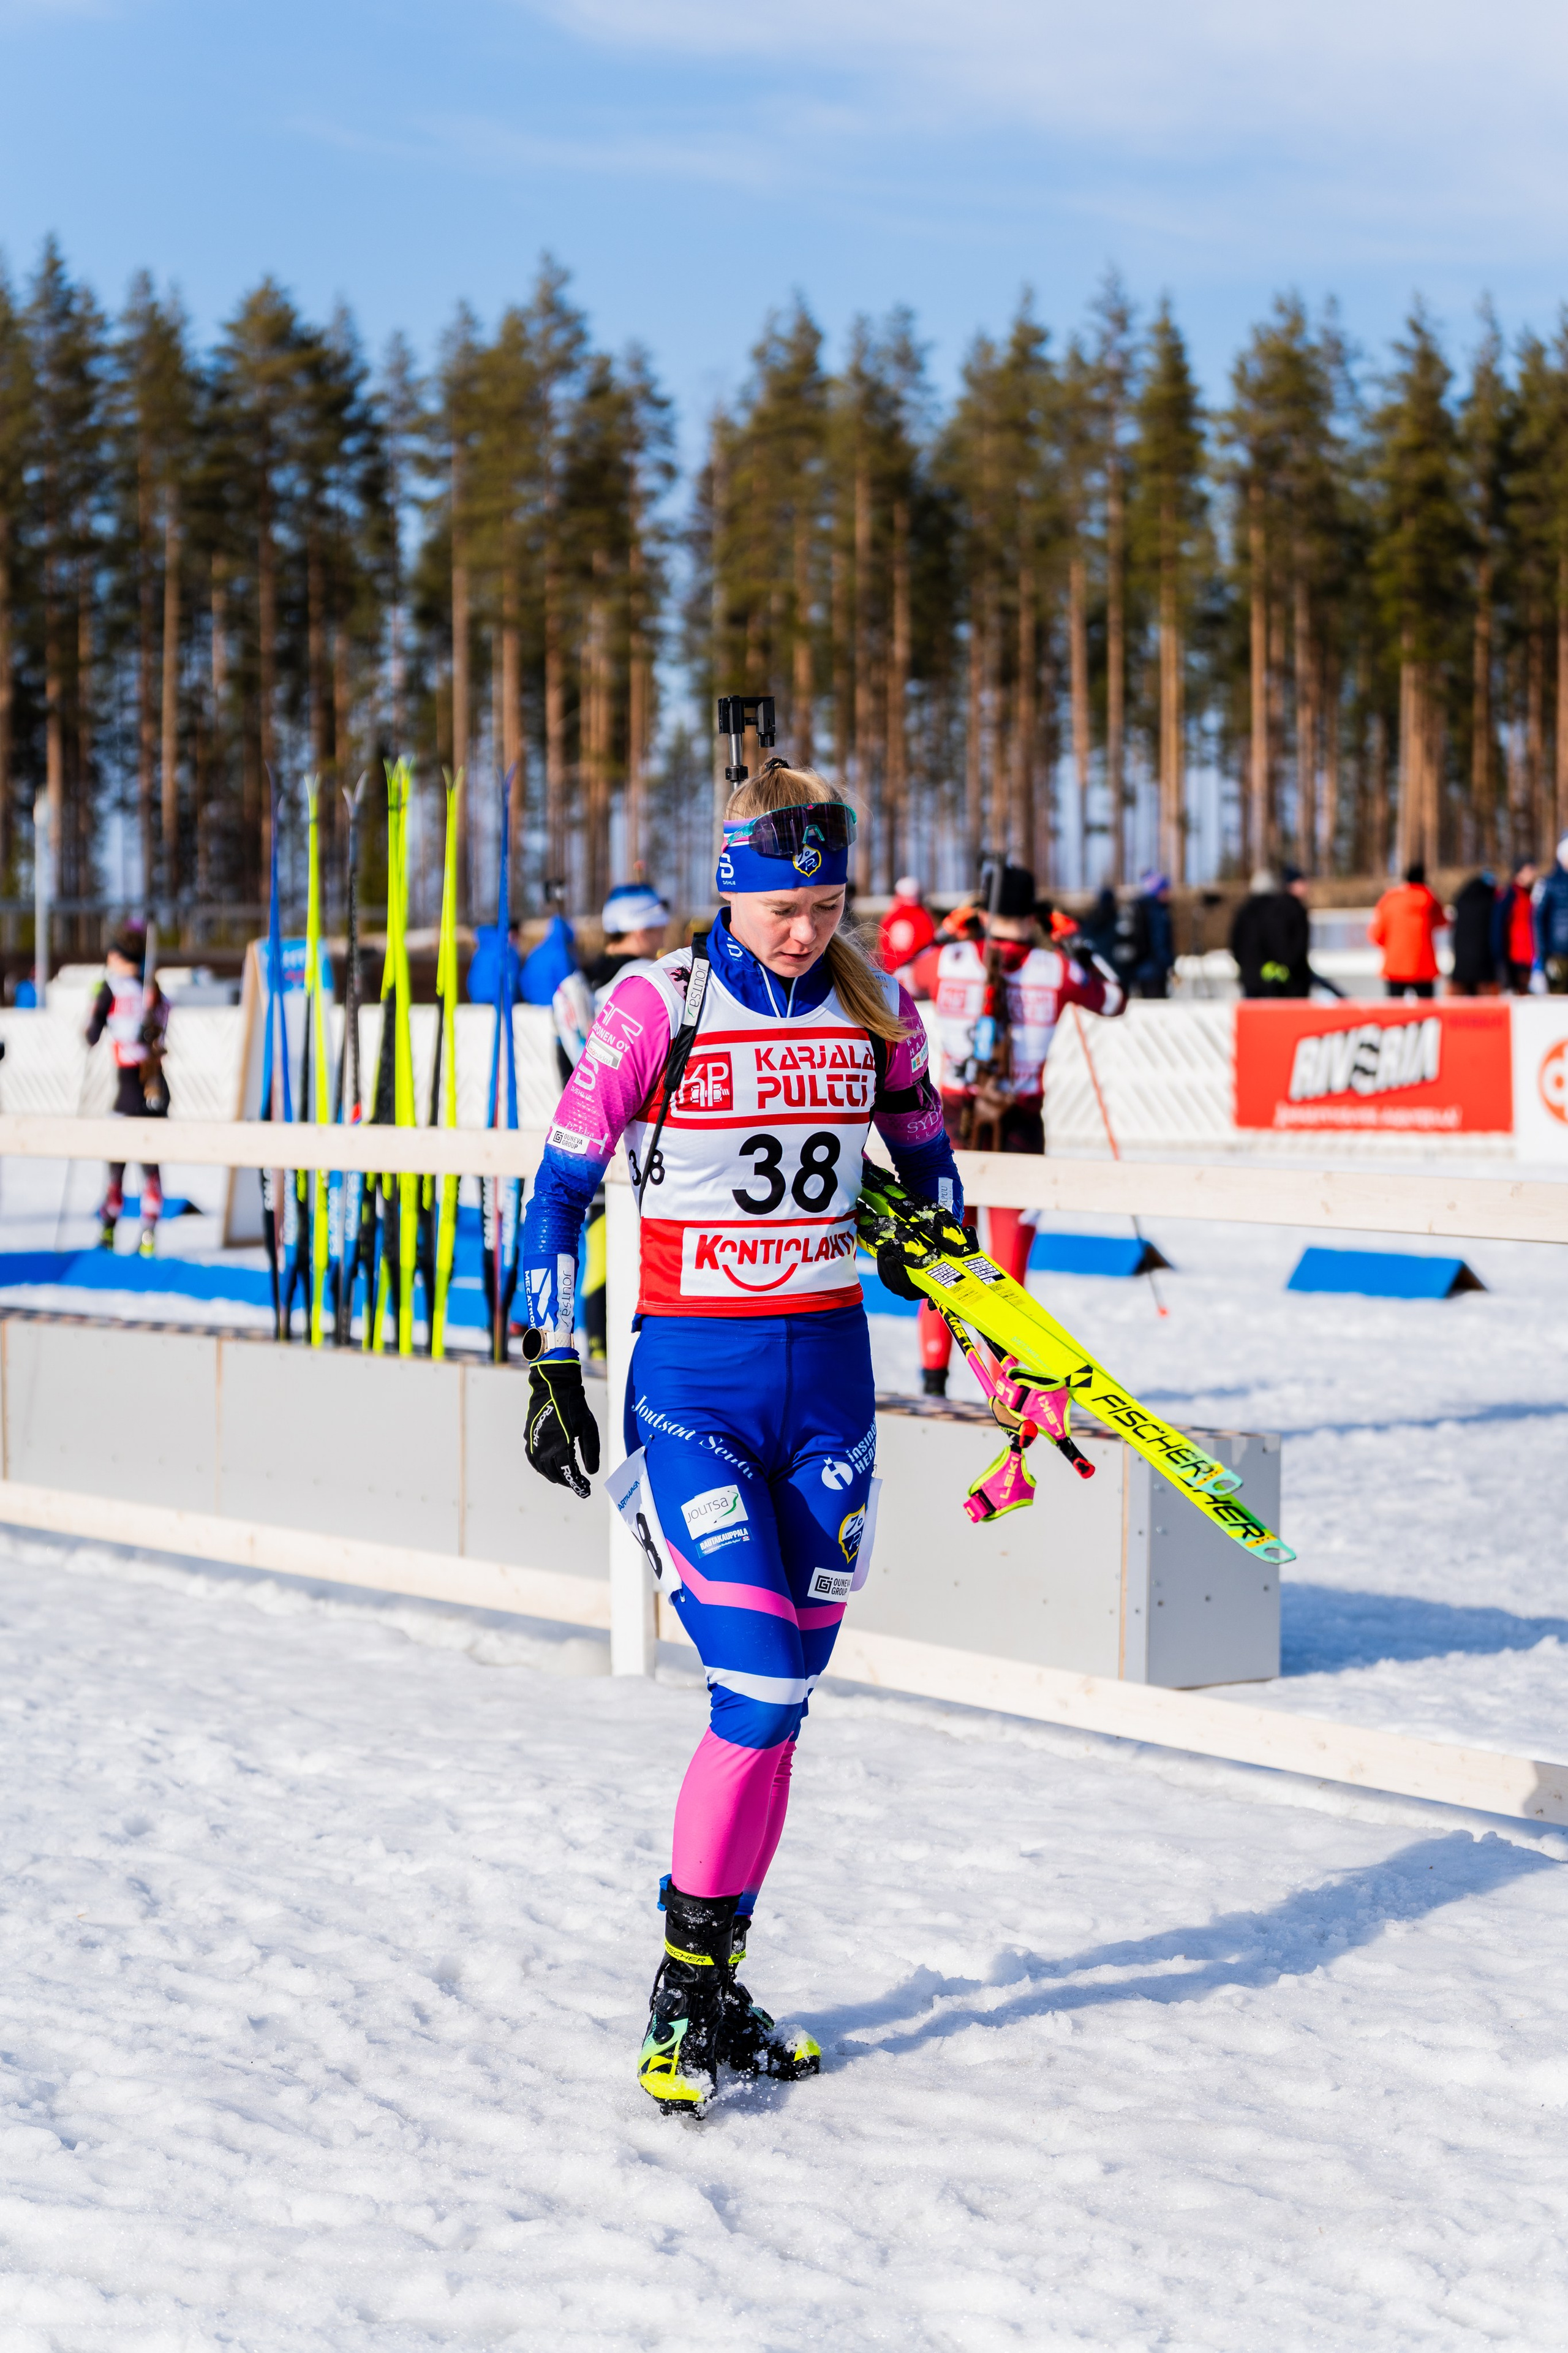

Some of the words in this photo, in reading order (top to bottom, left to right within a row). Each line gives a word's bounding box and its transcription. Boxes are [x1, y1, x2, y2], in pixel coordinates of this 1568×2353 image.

[755, 1045, 875, 1071] KARJALA
[757, 1074, 868, 1109] PULTTI
[561, 1139, 578, 1150] GROUP
[564, 1133, 584, 1146] OUNEVA
[628, 1149, 666, 1186] 38
[731, 1131, 841, 1215] 38
[694, 1231, 856, 1270] KONTIOLAHTI
[631, 1394, 696, 1441] Joutsan
[1038, 1395, 1063, 1437] LEKI
[1091, 1394, 1215, 1478] FISCHER
[999, 1456, 1020, 1500] LEKI
[699, 1527, 749, 1551] RAUTAKAUPPALA
[665, 1941, 706, 1964] FISCHER
